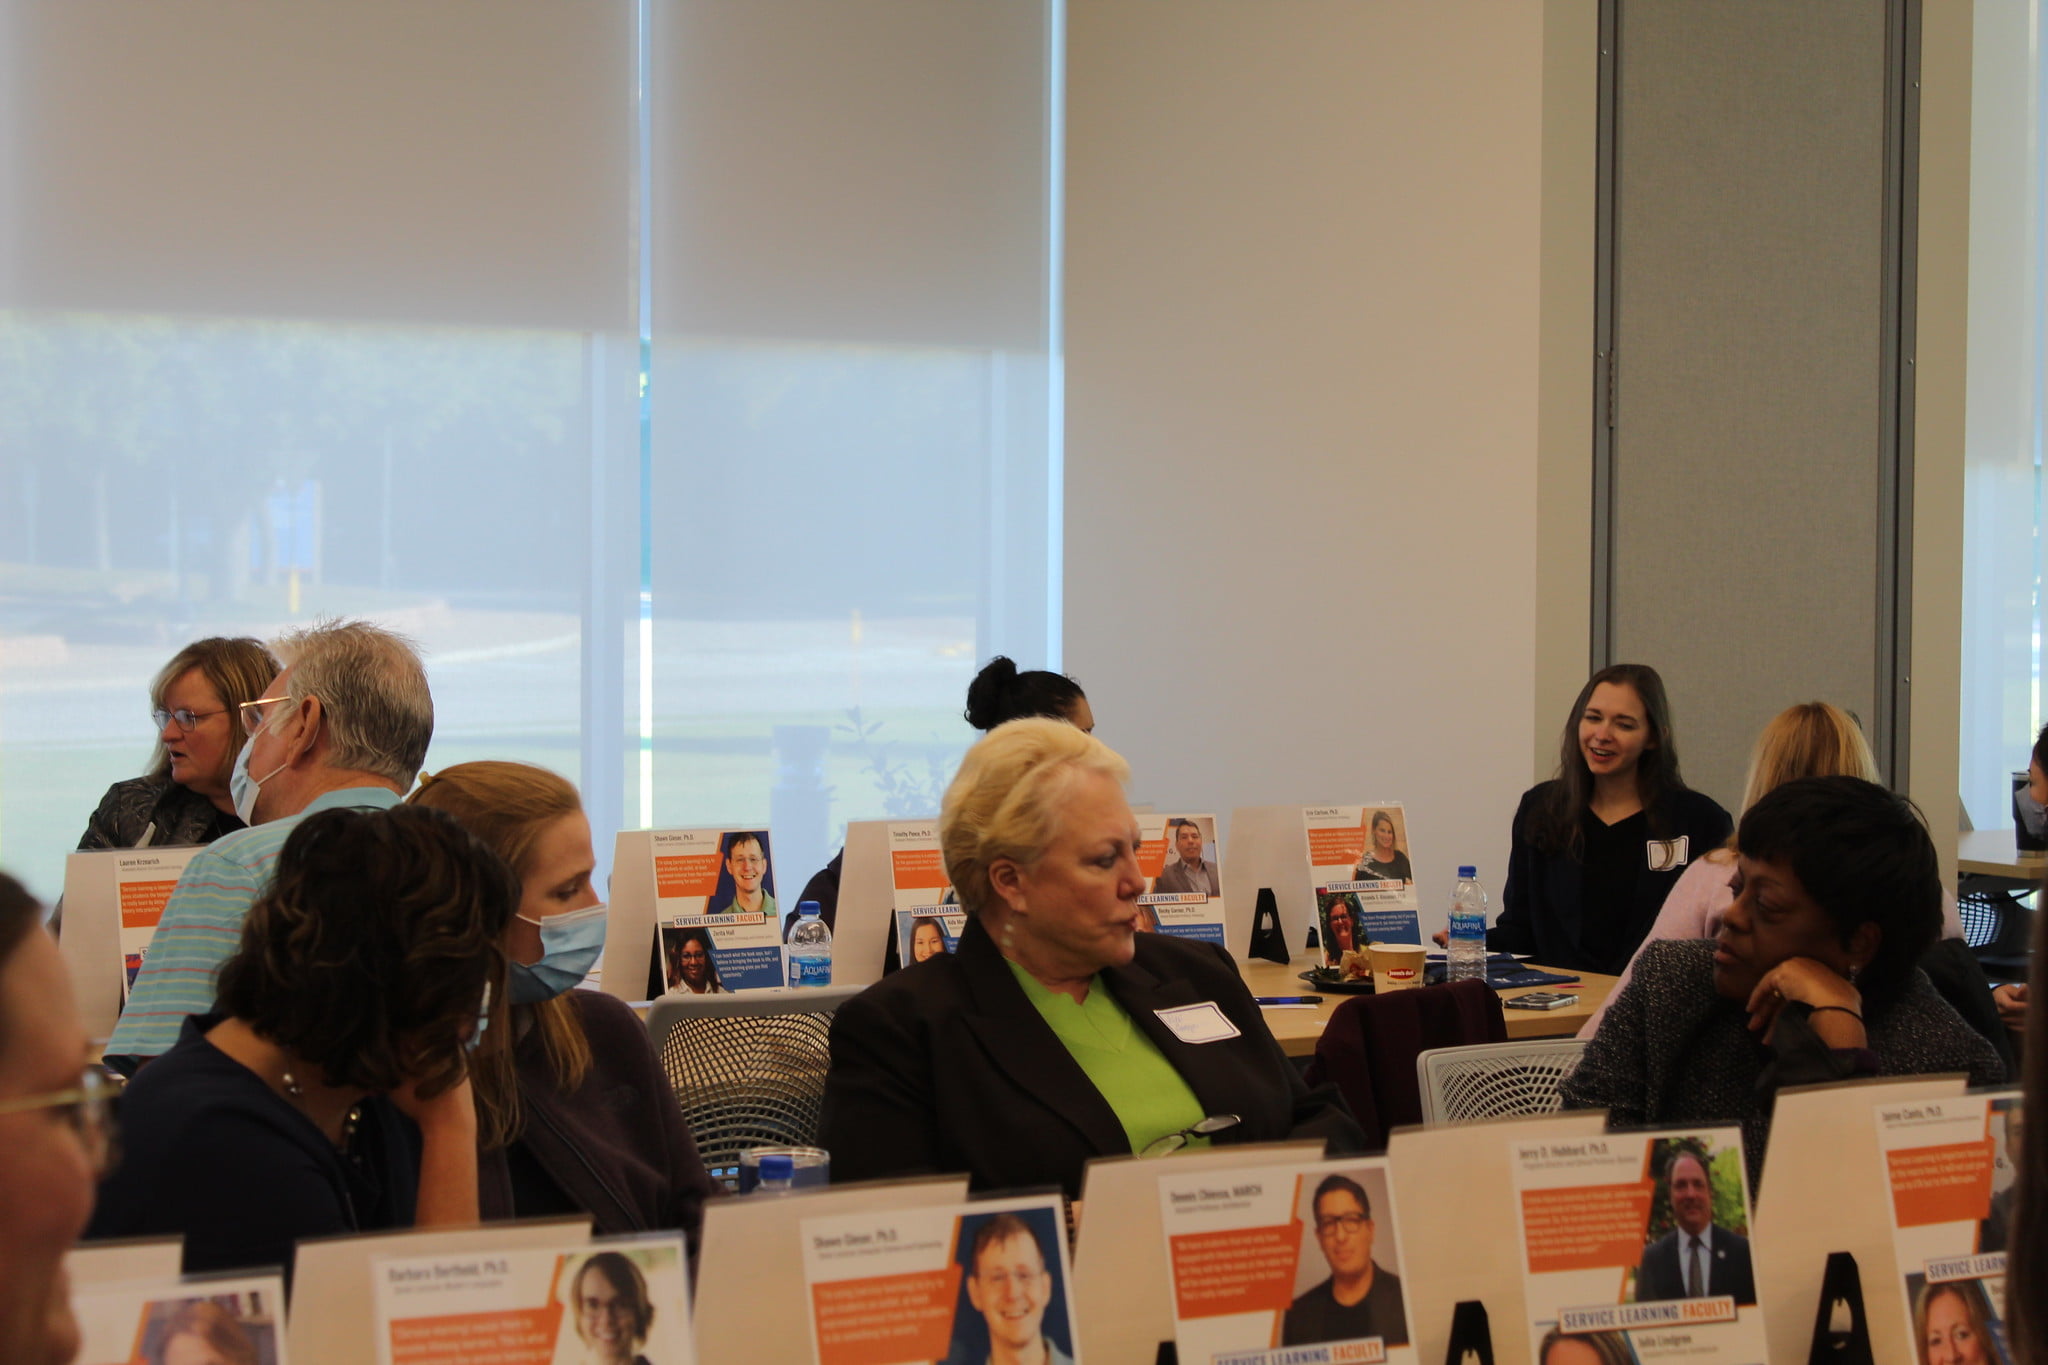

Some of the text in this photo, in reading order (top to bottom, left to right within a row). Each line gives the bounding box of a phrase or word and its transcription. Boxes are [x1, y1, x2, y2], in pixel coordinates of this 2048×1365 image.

[1353, 882, 1379, 890] LEARNING
[1180, 894, 1205, 902] FACULTY
[676, 913, 763, 926] SERVICE LEARNING FACULTY
[1452, 921, 1482, 930] AQUAFINA
[1928, 1263, 1970, 1279] SERVICE
[1564, 1300, 1732, 1328] SERVICE LEARNING FACULTY
[1333, 1342, 1380, 1360] FACULTY
